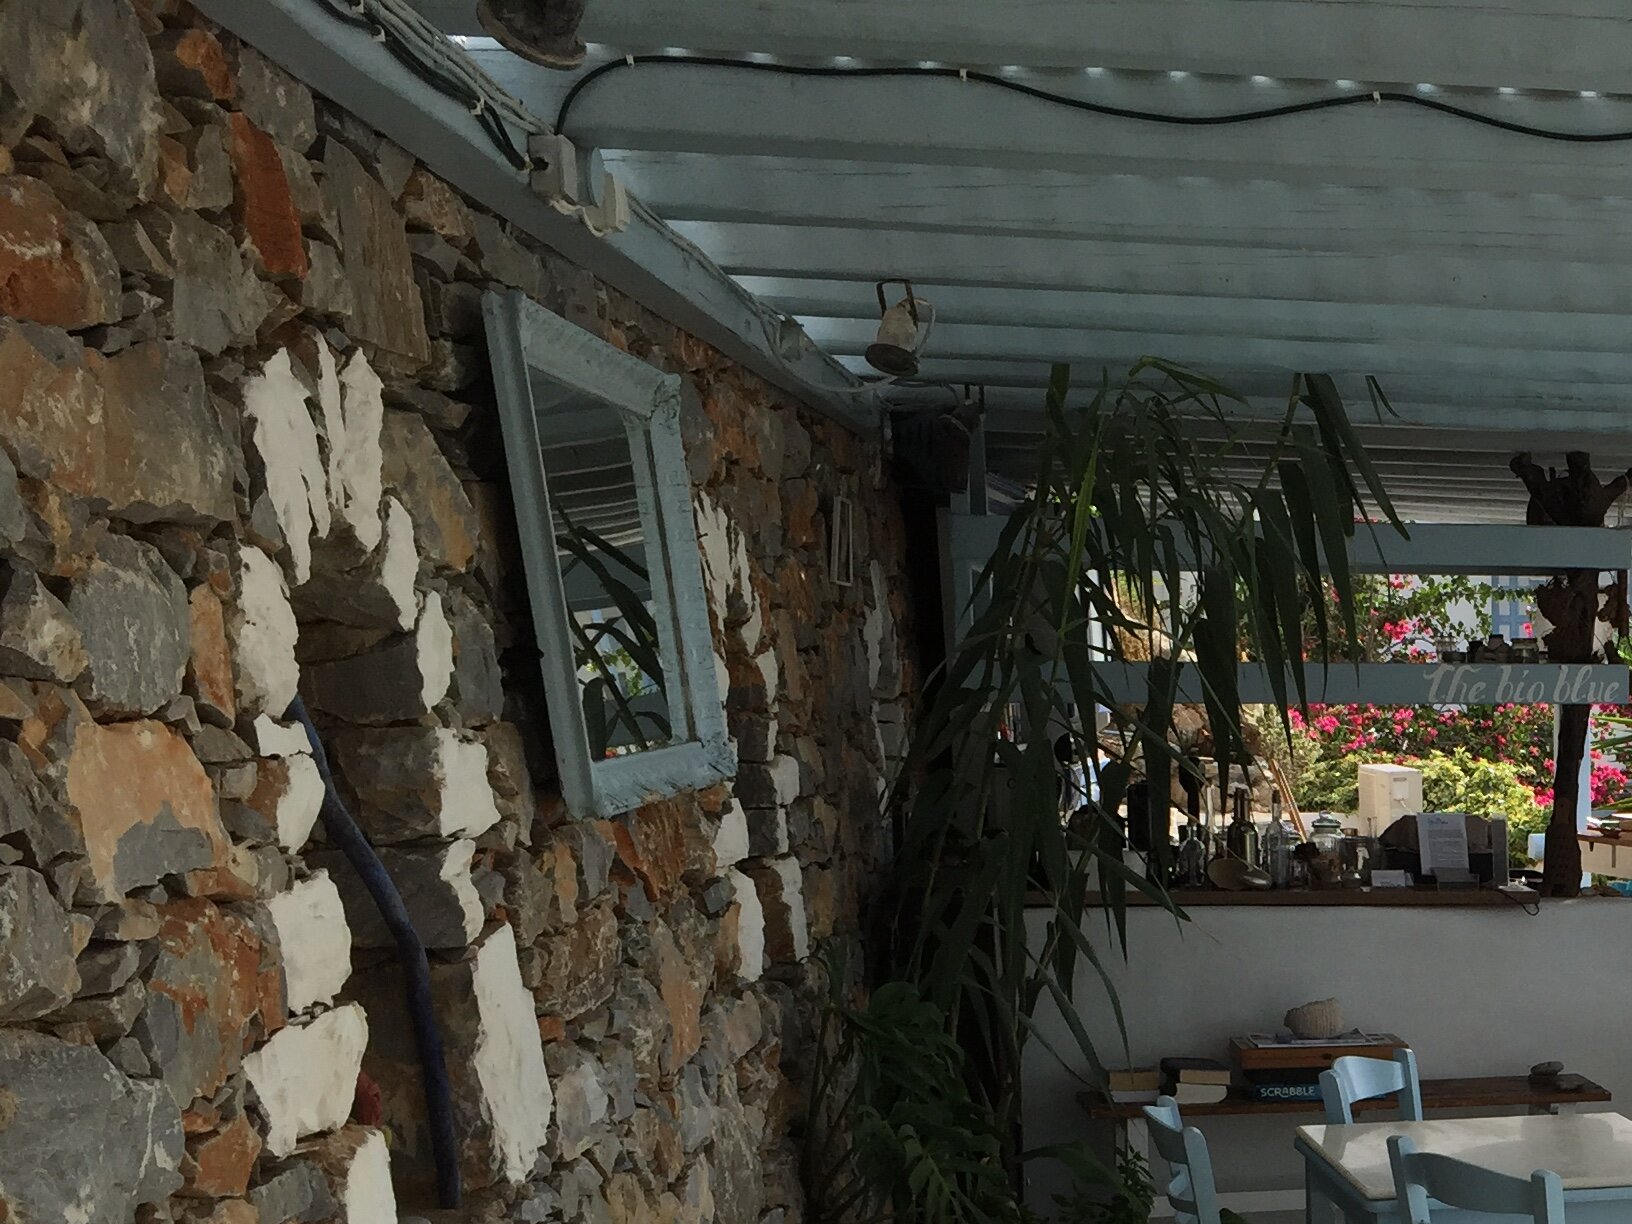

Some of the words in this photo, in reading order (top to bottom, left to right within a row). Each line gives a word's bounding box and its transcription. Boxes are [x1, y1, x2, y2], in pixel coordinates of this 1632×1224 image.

[1423, 664, 1487, 703] The
[1553, 665, 1621, 703] blue
[1260, 1086, 1316, 1097] SCRABBLE
